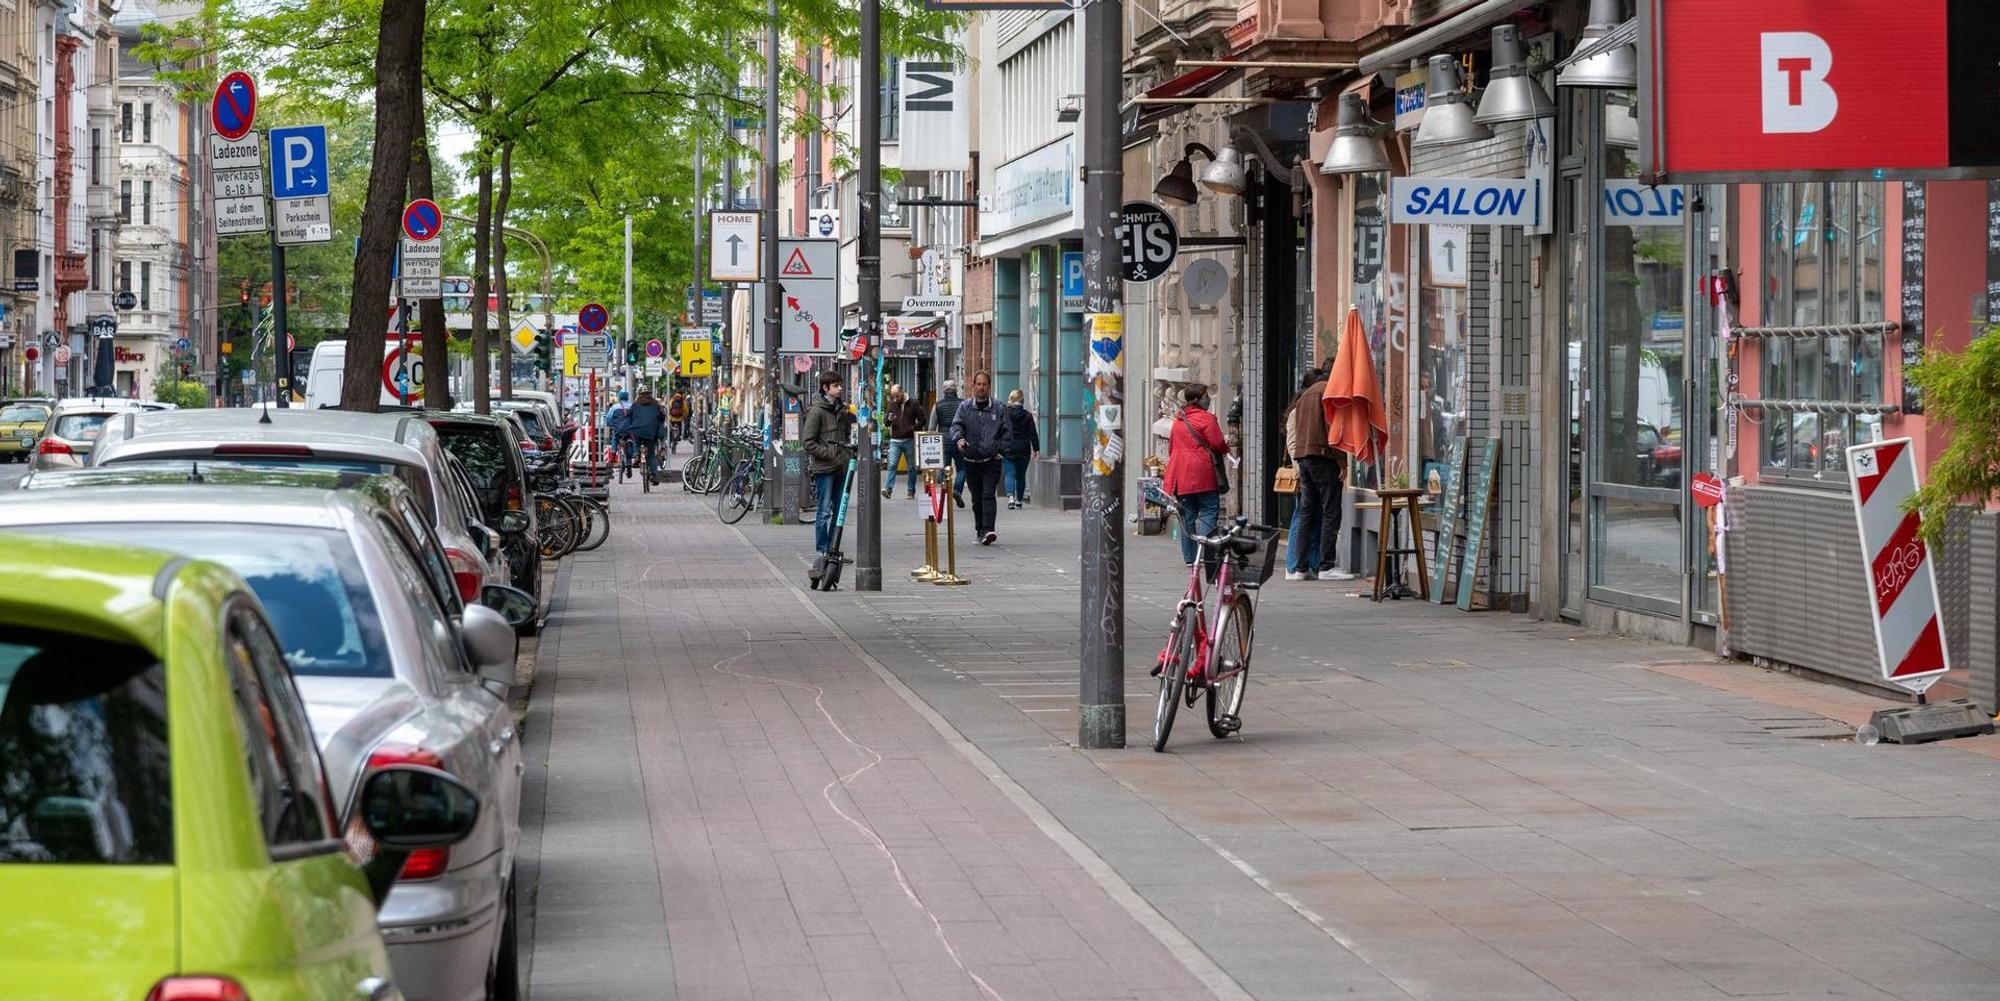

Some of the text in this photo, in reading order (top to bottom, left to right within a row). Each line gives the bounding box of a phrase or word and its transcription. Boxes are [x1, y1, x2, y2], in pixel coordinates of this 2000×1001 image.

[213, 143, 258, 160] Ladezone
[284, 136, 314, 190] P
[216, 170, 260, 183] werktags
[1406, 187, 1526, 216] SALON
[226, 202, 254, 215] auf dem
[218, 216, 264, 229] Seitenstreifen
[285, 212, 321, 223] Parkschein
[717, 215, 753, 223] HOME
[1122, 212, 1163, 223] HMITZ
[280, 226, 307, 241] werktags
[404, 243, 440, 254] Ladezone
[405, 261, 439, 269] werktags
[1069, 259, 1083, 290] P
[404, 287, 439, 295] Seitenstreifen
[906, 298, 955, 308] Overmann
[93, 326, 114, 336] BAR
[692, 342, 701, 353] U
[922, 436, 941, 444] EIS
